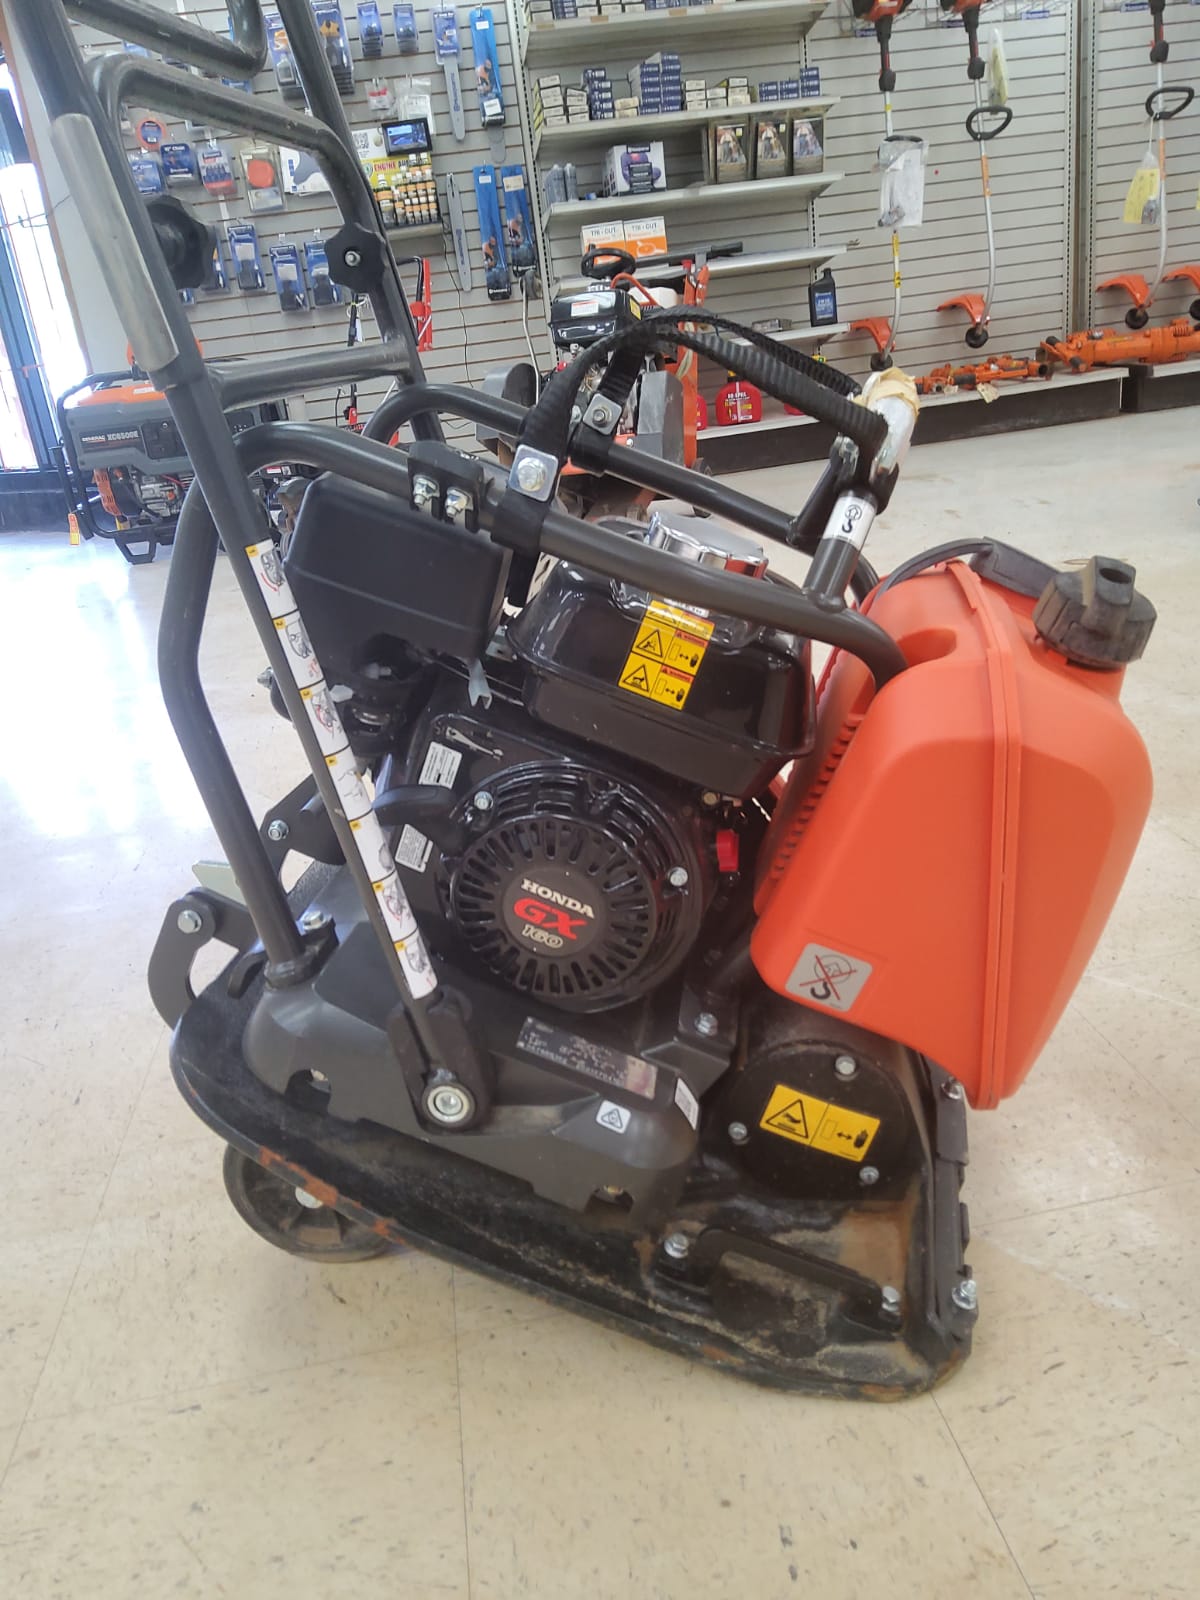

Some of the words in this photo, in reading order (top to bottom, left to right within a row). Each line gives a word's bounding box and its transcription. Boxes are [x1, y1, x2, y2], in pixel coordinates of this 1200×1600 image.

[513, 897, 588, 941] GX
[520, 878, 595, 919] HONDA
[521, 923, 564, 949] 160
